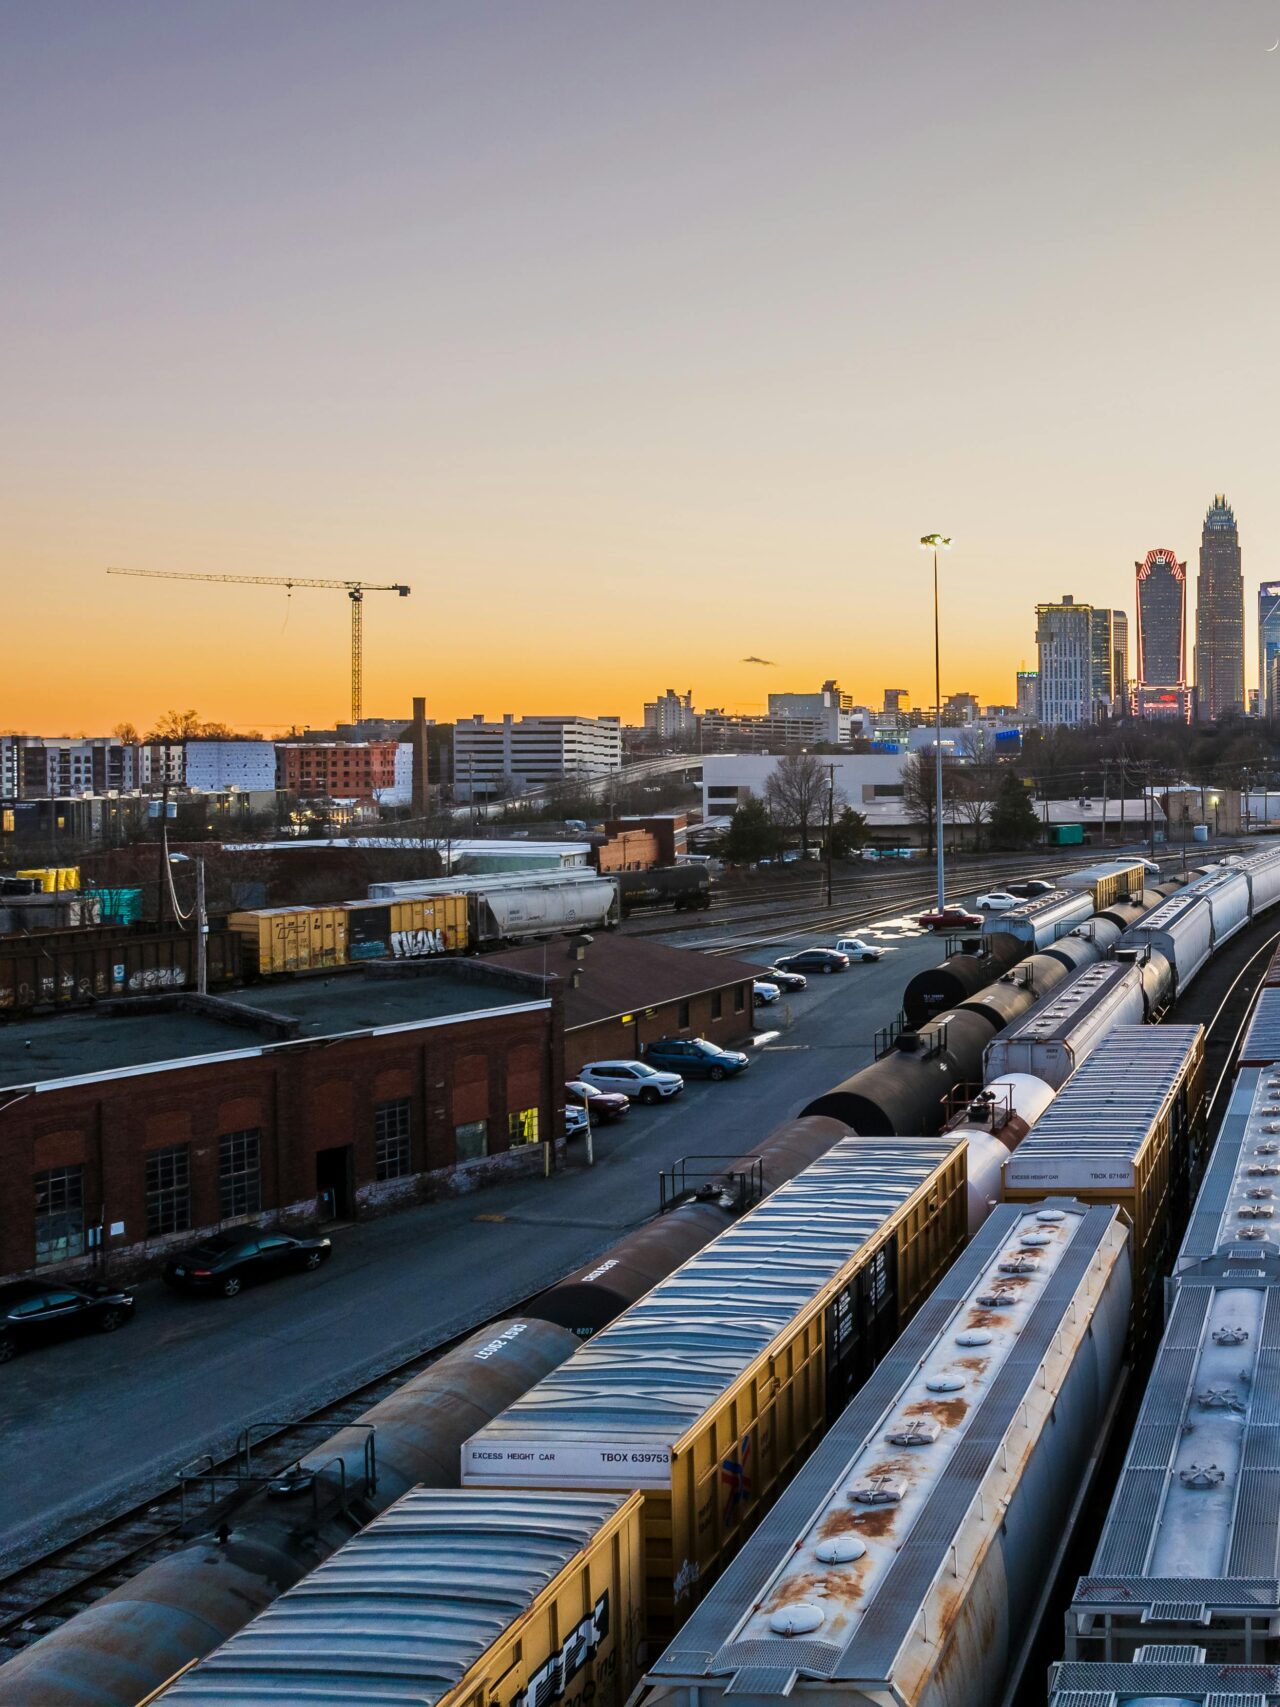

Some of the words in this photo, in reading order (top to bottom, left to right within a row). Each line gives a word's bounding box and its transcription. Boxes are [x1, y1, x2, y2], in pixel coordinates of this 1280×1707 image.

[474, 1339, 508, 1360] 29037
[472, 1452, 503, 1460] EXCESS
[506, 1452, 535, 1461] HEIGHT
[538, 1453, 556, 1461] CAR
[600, 1453, 629, 1463] TBOX
[630, 1454, 670, 1464] 639753
